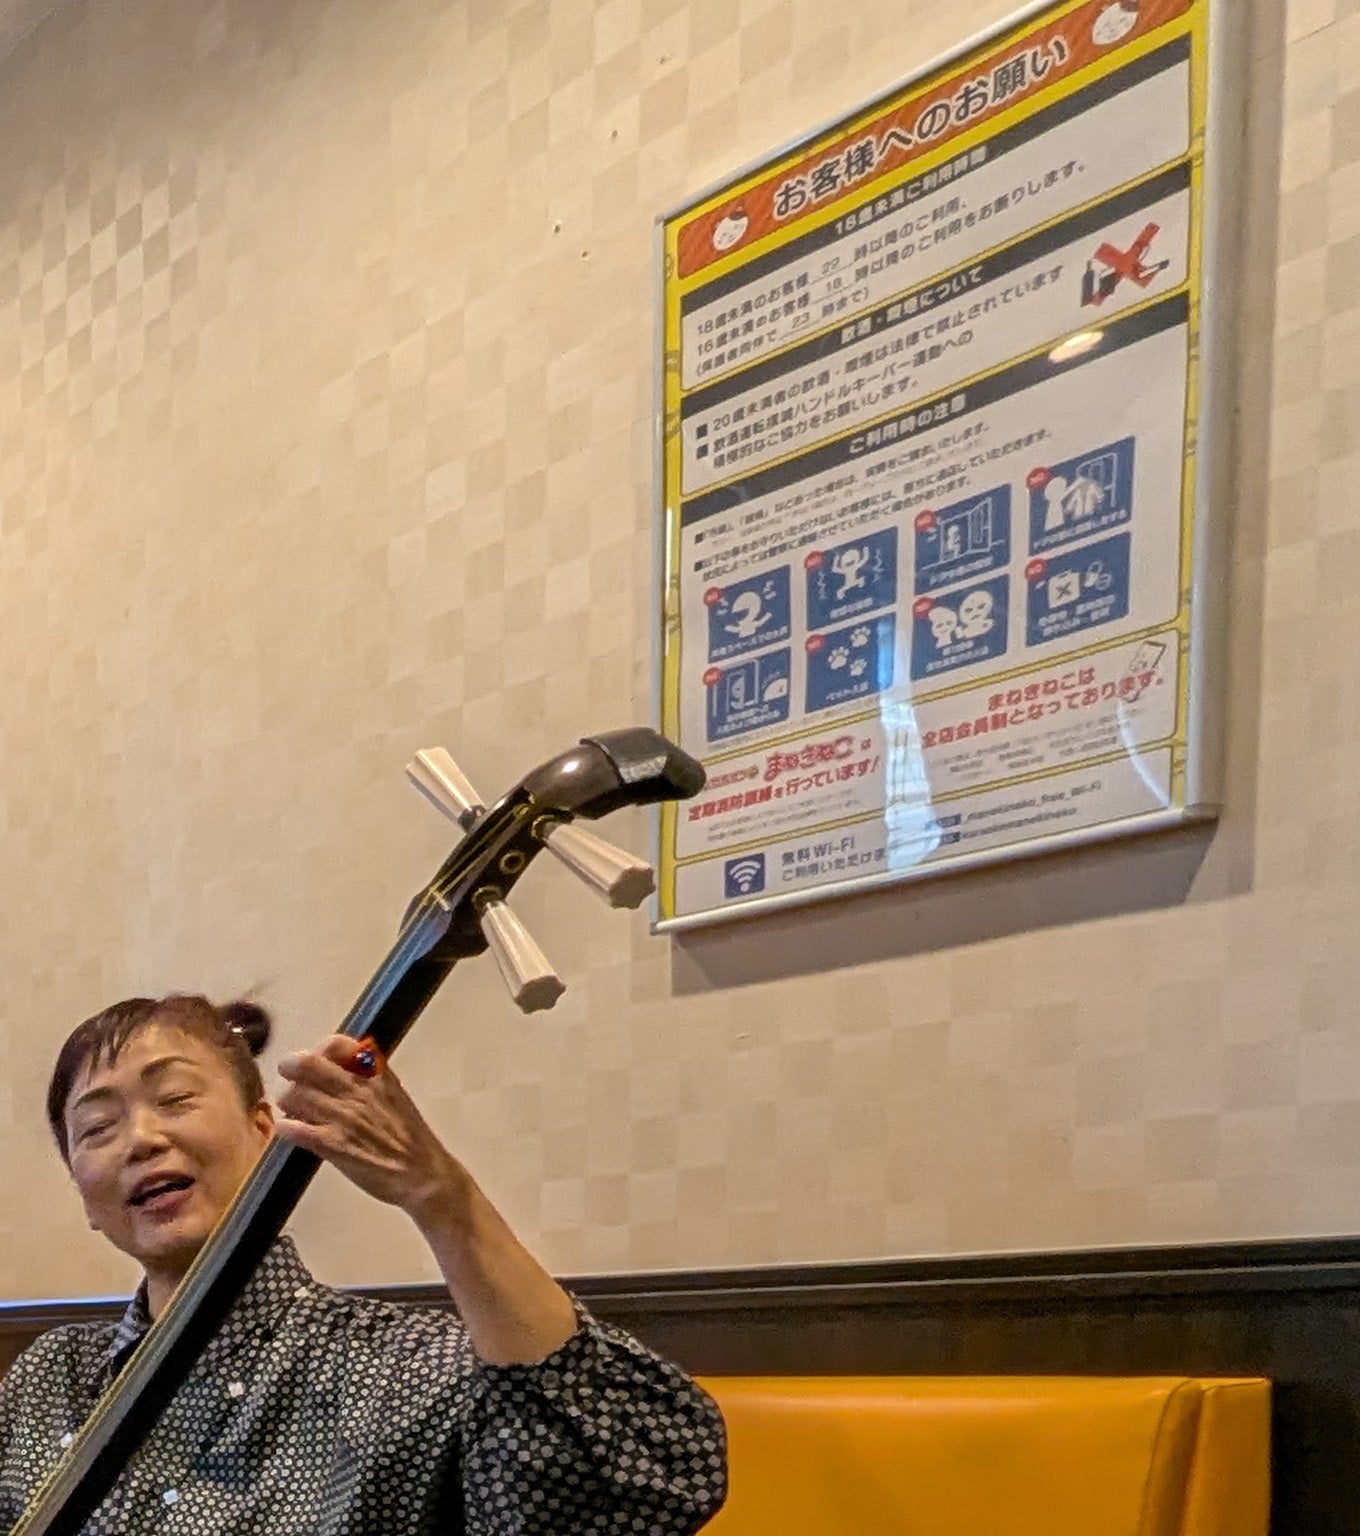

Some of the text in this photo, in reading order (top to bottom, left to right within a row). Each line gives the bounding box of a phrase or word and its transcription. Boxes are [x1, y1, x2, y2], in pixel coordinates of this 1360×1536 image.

[775, 40, 1067, 217] お客様へのお願い
[849, 394, 966, 454] ご利用時の注意
[922, 670, 1164, 748] 全店会員制となっております。
[987, 667, 1095, 711] まねきねこは
